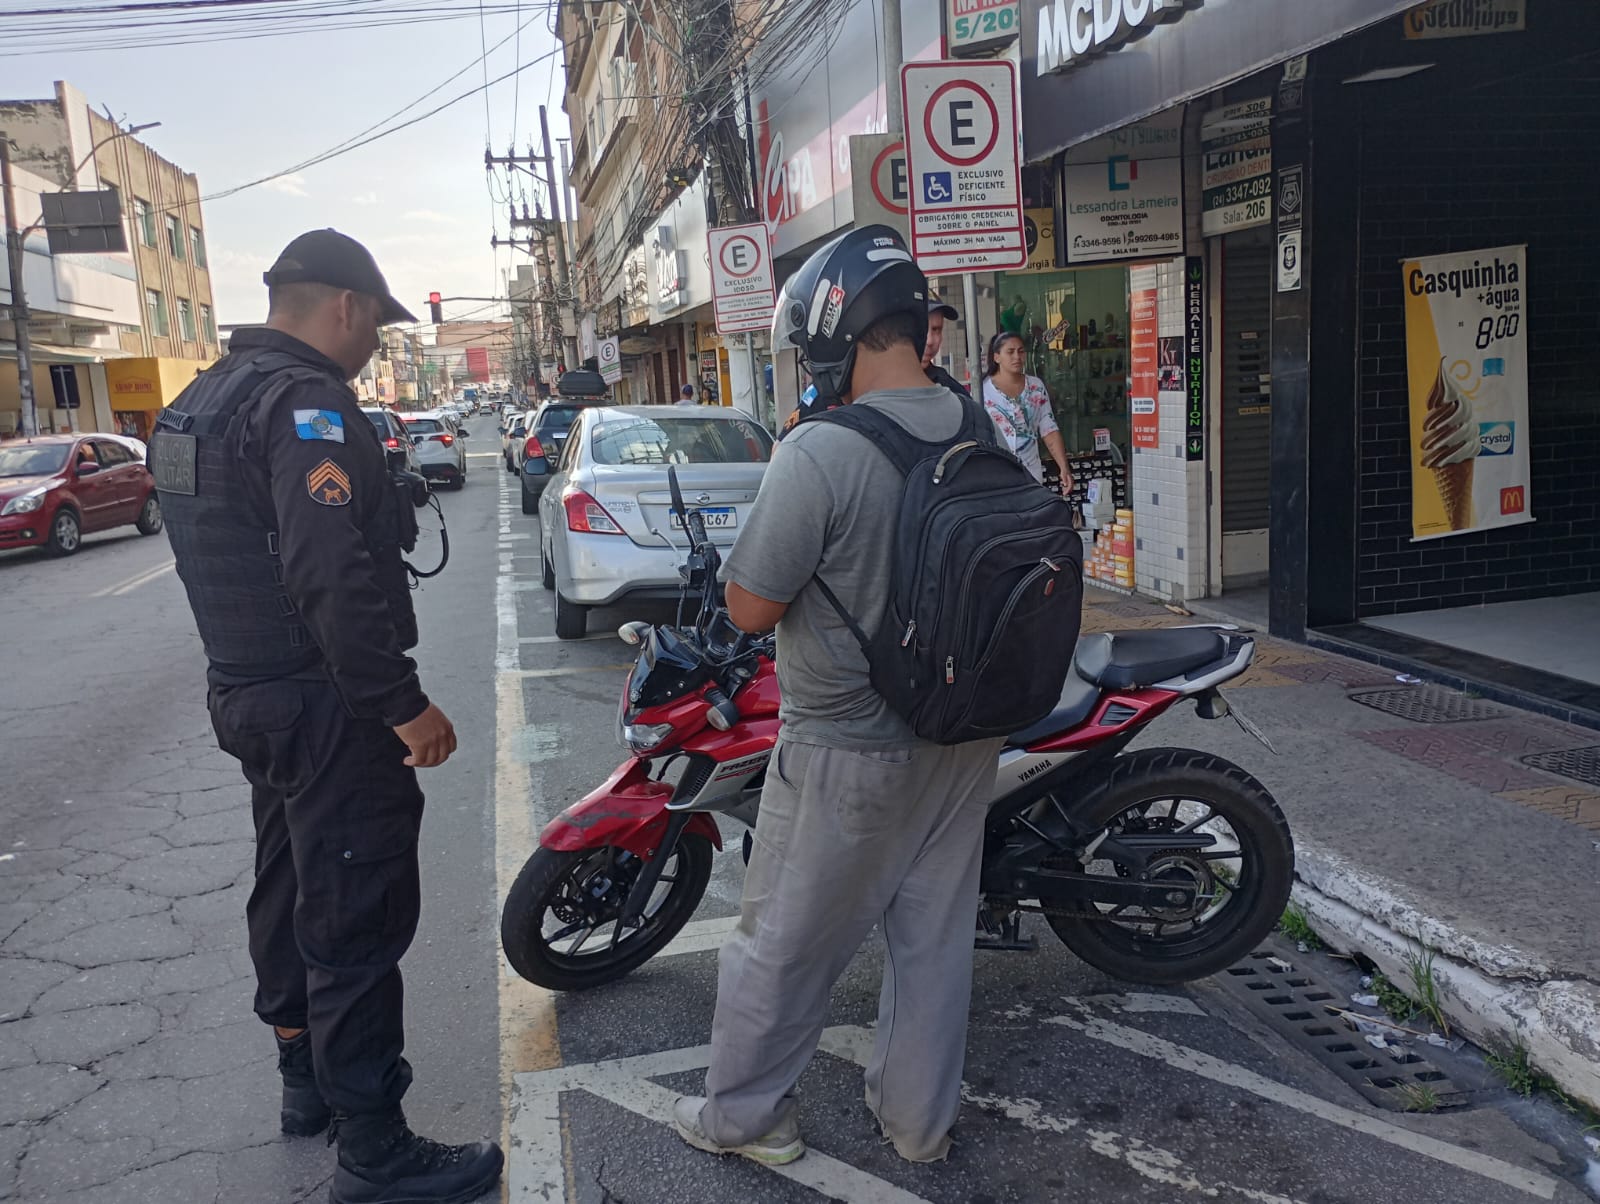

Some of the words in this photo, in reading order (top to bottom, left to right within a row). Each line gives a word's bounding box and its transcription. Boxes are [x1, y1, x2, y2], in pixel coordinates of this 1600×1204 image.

[949, 101, 975, 145] E
[891, 159, 908, 200] E
[958, 170, 1003, 179] EXCLUSIVO
[959, 181, 1005, 190] DEFICIENTE
[960, 192, 986, 202] FÍSICO
[1070, 199, 1128, 215] Lessandra
[1132, 196, 1178, 210] Lameira
[1223, 211, 1244, 225] Sala:
[1245, 201, 1266, 220] 206
[918, 212, 968, 223] OBRIGATÓRIO
[971, 211, 1015, 219] CREDENCIAL
[1100, 212, 1148, 223] ODONTOLOGIA
[937, 222, 962, 230] SOBRE
[933, 237, 961, 246] MÁXIMO
[732, 245, 748, 268] E
[724, 276, 762, 287] EXCLUSIVO
[1410, 258, 1519, 298] Casquinha
[1477, 286, 1519, 309] +água
[1190, 283, 1201, 353] HERBALIFE
[605, 346, 612, 357] E
[1190, 358, 1201, 426] NUTRITION
[1480, 432, 1511, 445] crystal
[1018, 760, 1052, 782] YAMAHA
